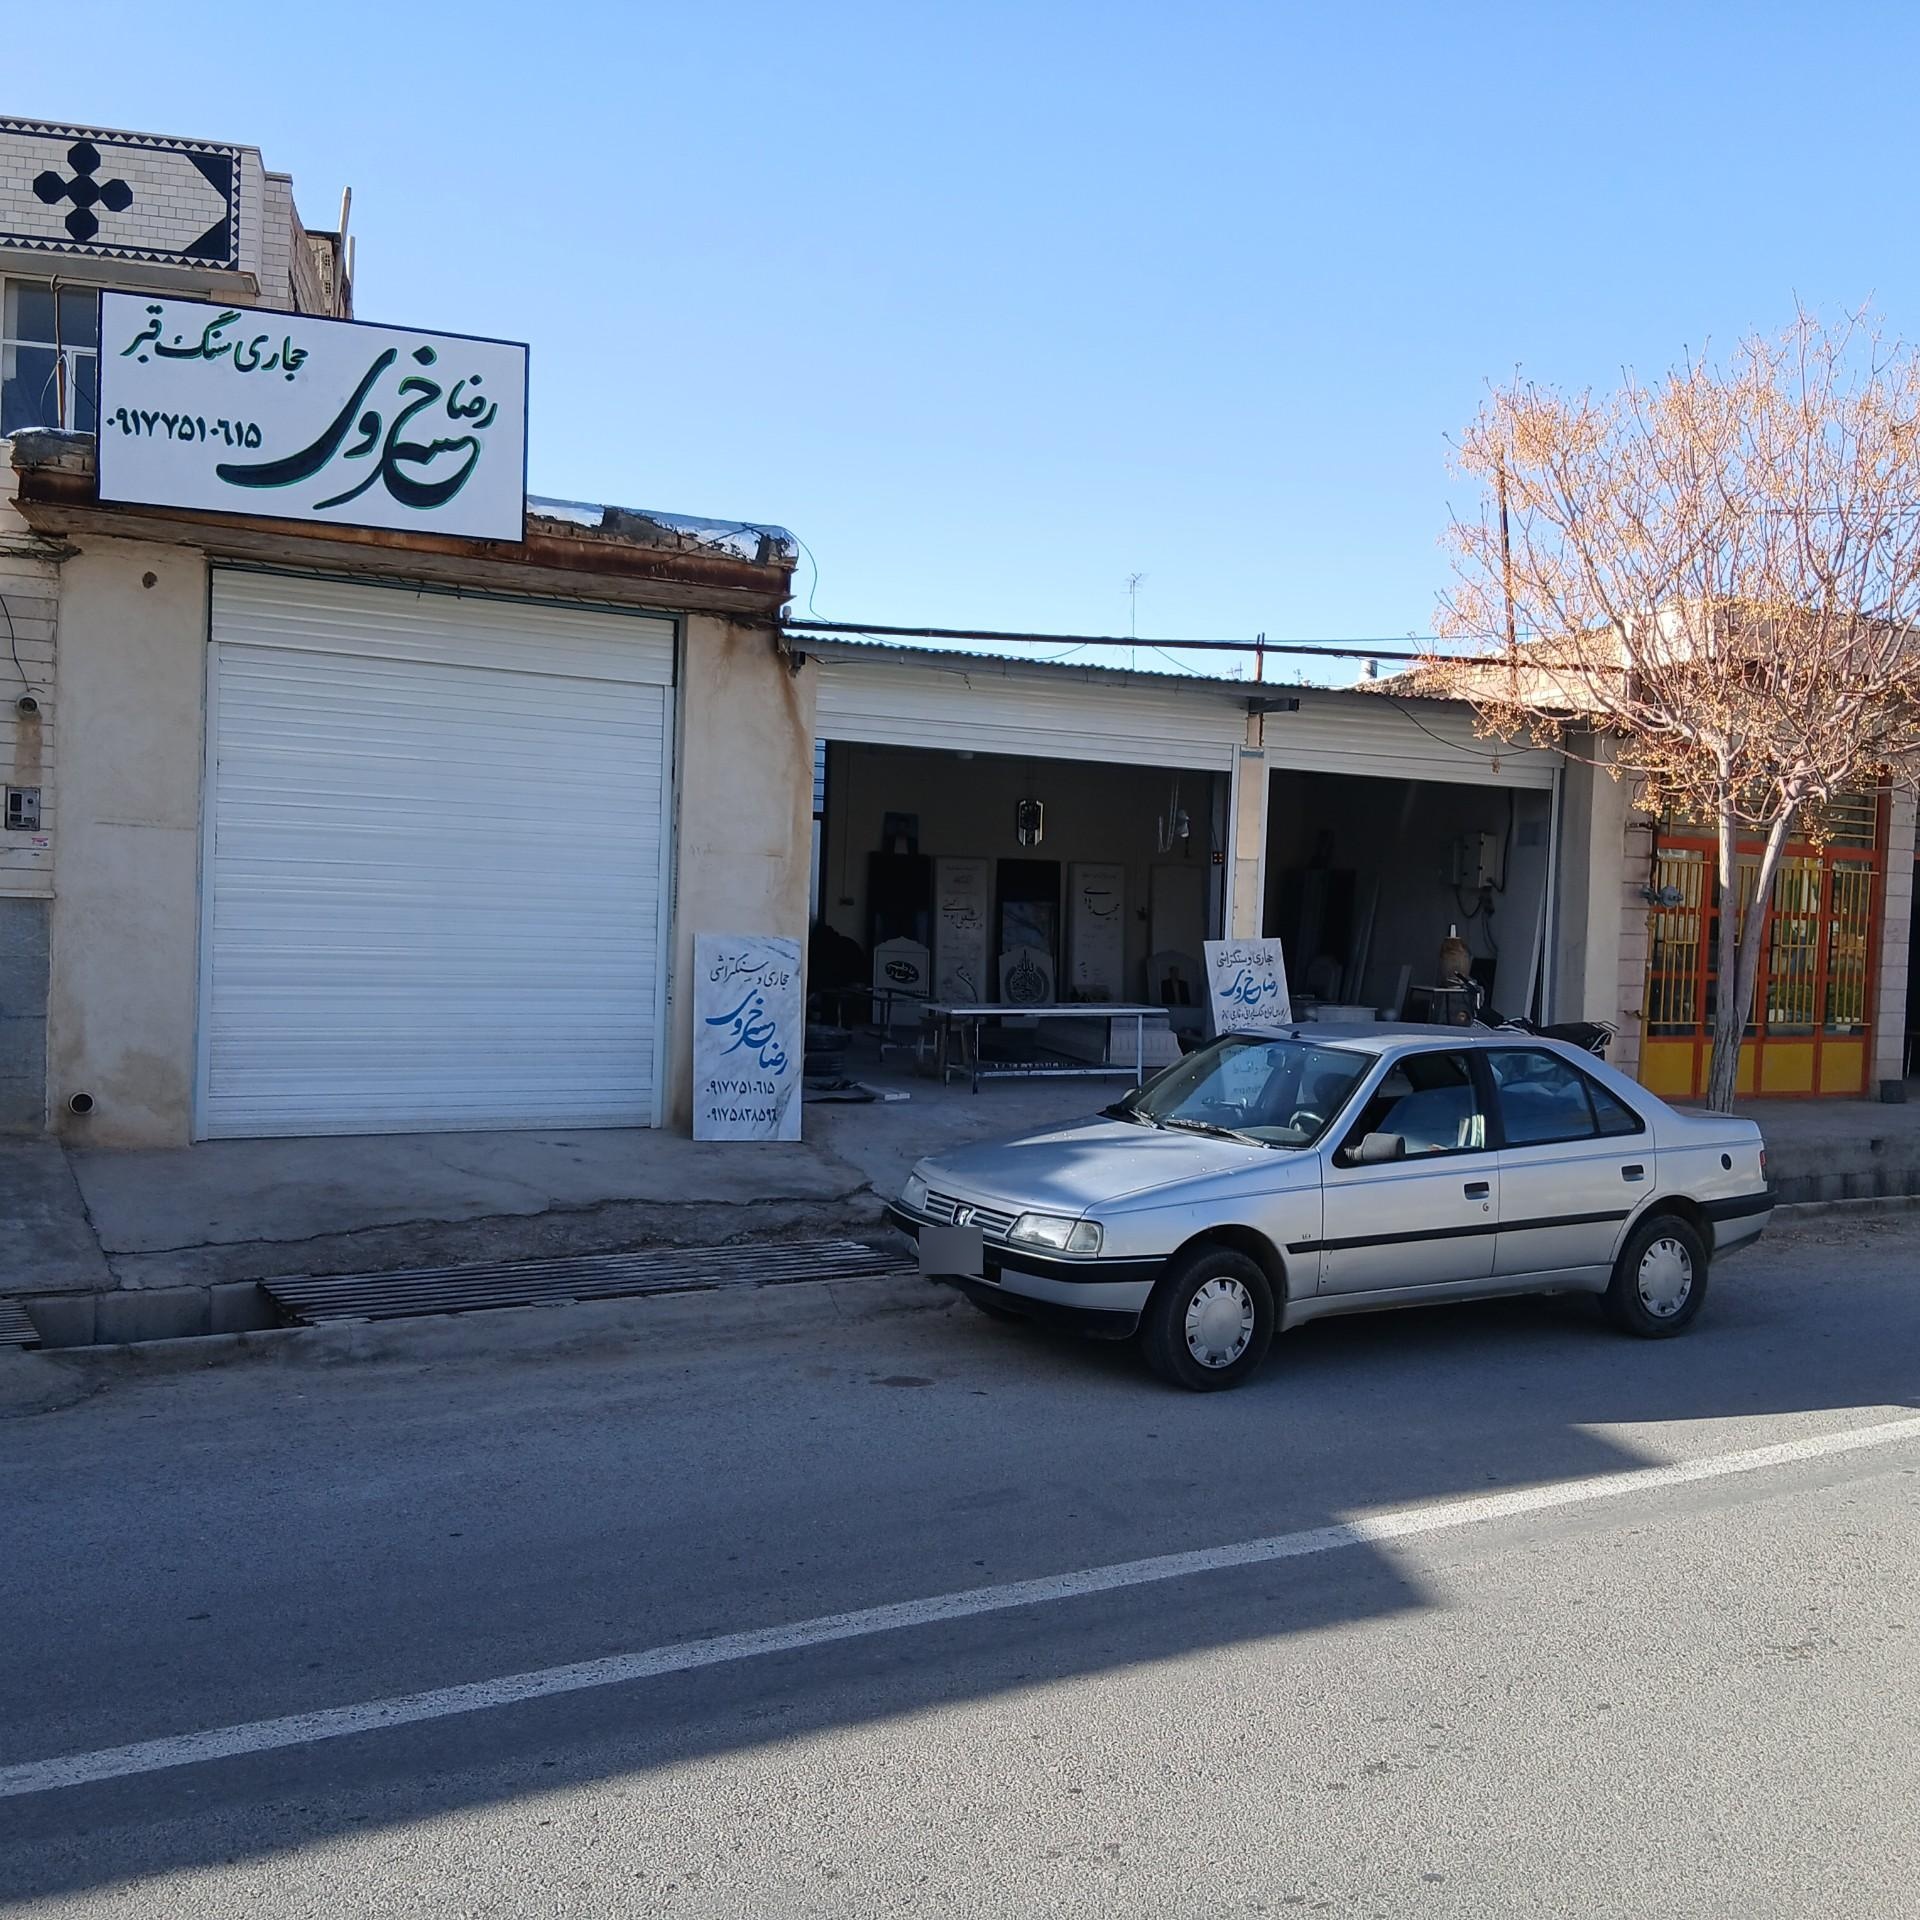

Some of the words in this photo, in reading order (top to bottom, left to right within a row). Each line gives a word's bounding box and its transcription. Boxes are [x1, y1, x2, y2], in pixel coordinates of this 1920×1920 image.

[120, 304, 163, 364] قبر
[154, 310, 243, 360] سنگ
[216, 344, 481, 510] خسروی
[446, 374, 498, 429] رضا
[1262, 972, 1279, 998] رضا
[705, 988, 776, 1056] خسروی
[758, 1041, 789, 1076] رضا
